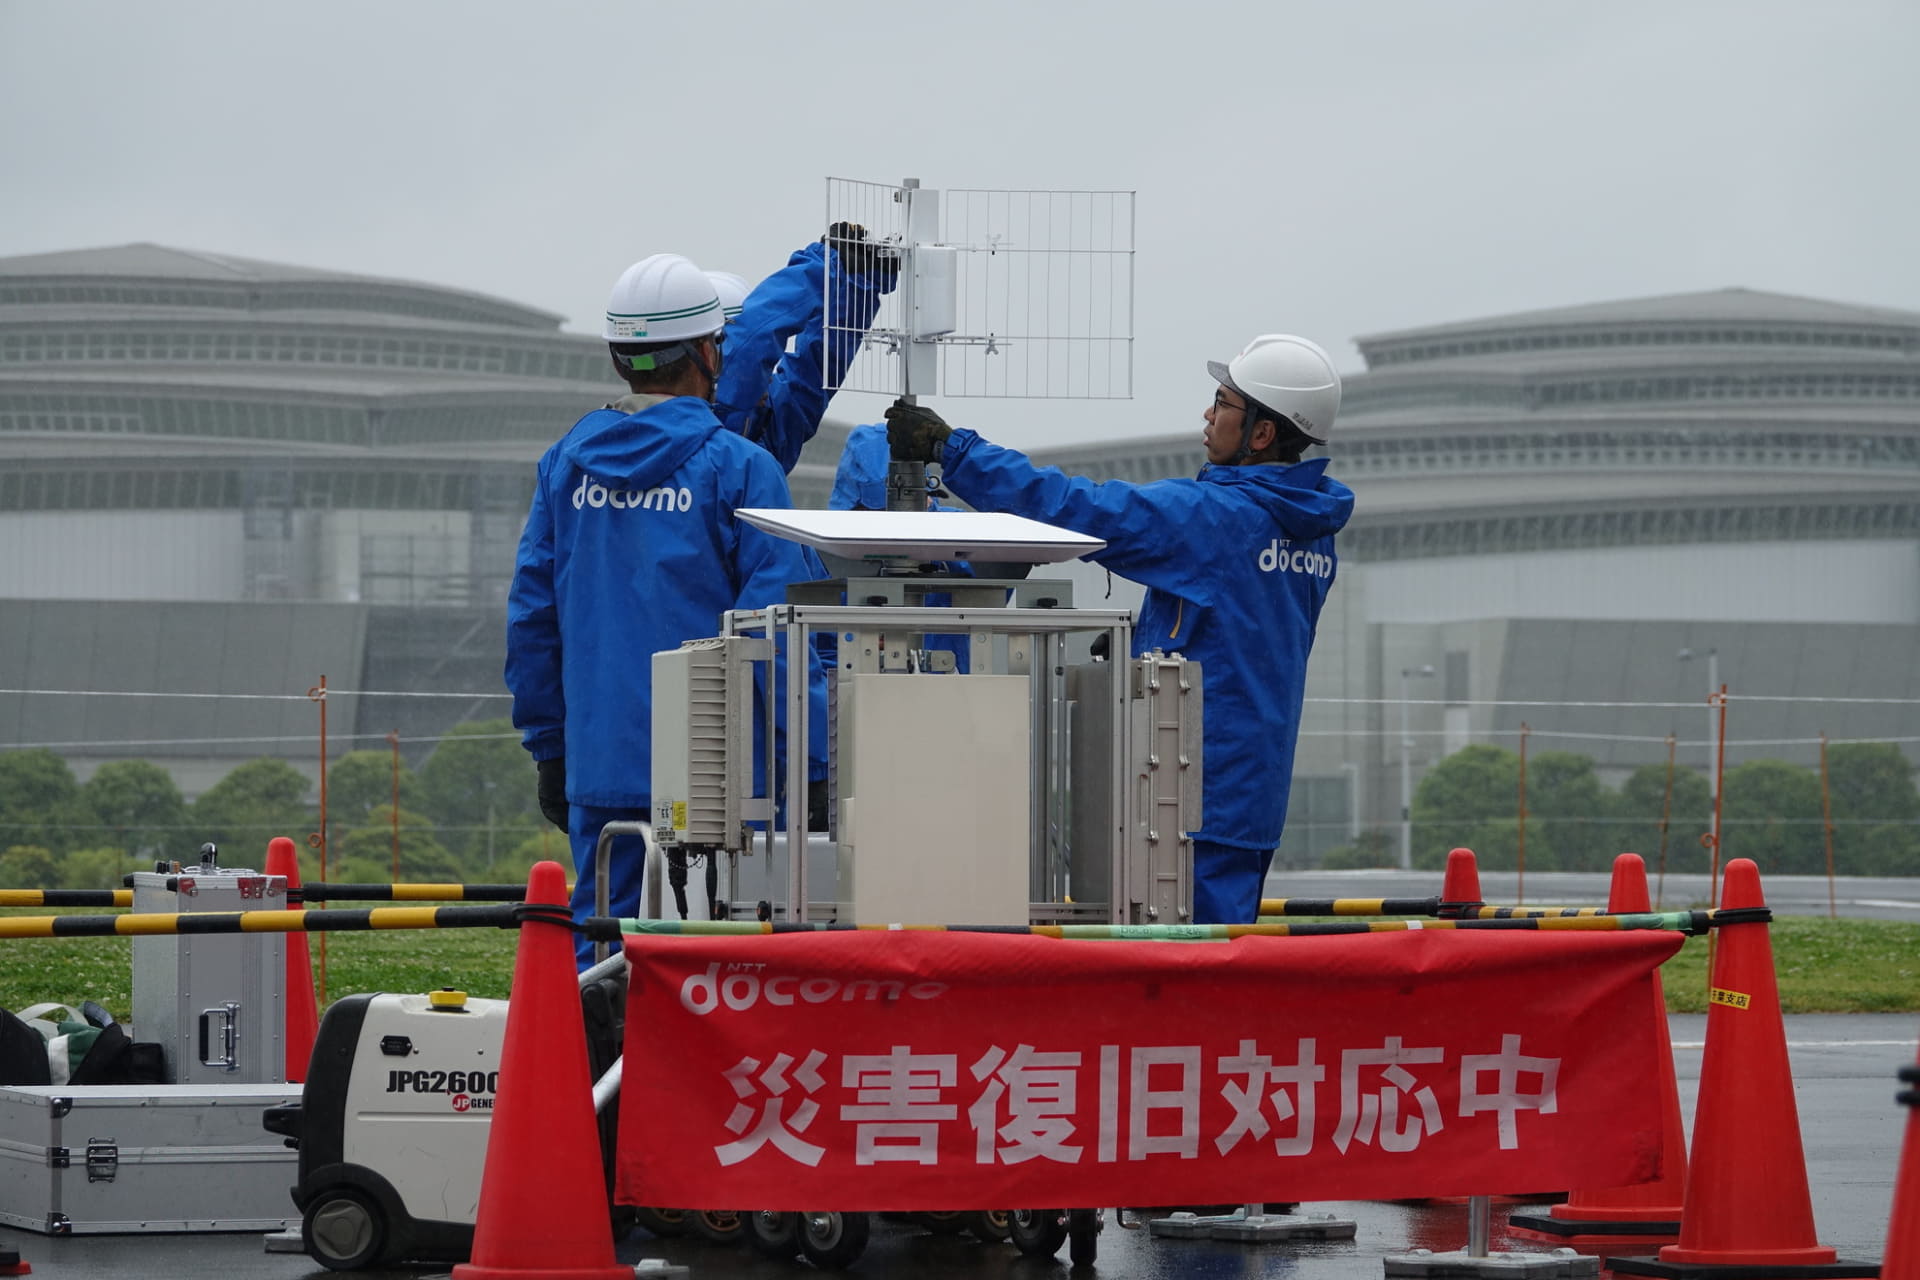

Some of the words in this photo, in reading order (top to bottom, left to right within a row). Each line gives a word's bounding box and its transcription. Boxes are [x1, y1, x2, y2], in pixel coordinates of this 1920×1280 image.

[572, 474, 692, 512] docomo
[726, 962, 767, 973] NTT
[680, 962, 949, 1015] docomo
[471, 1098, 496, 1108] GENE
[714, 1034, 1561, 1168] 災害復旧対応中
